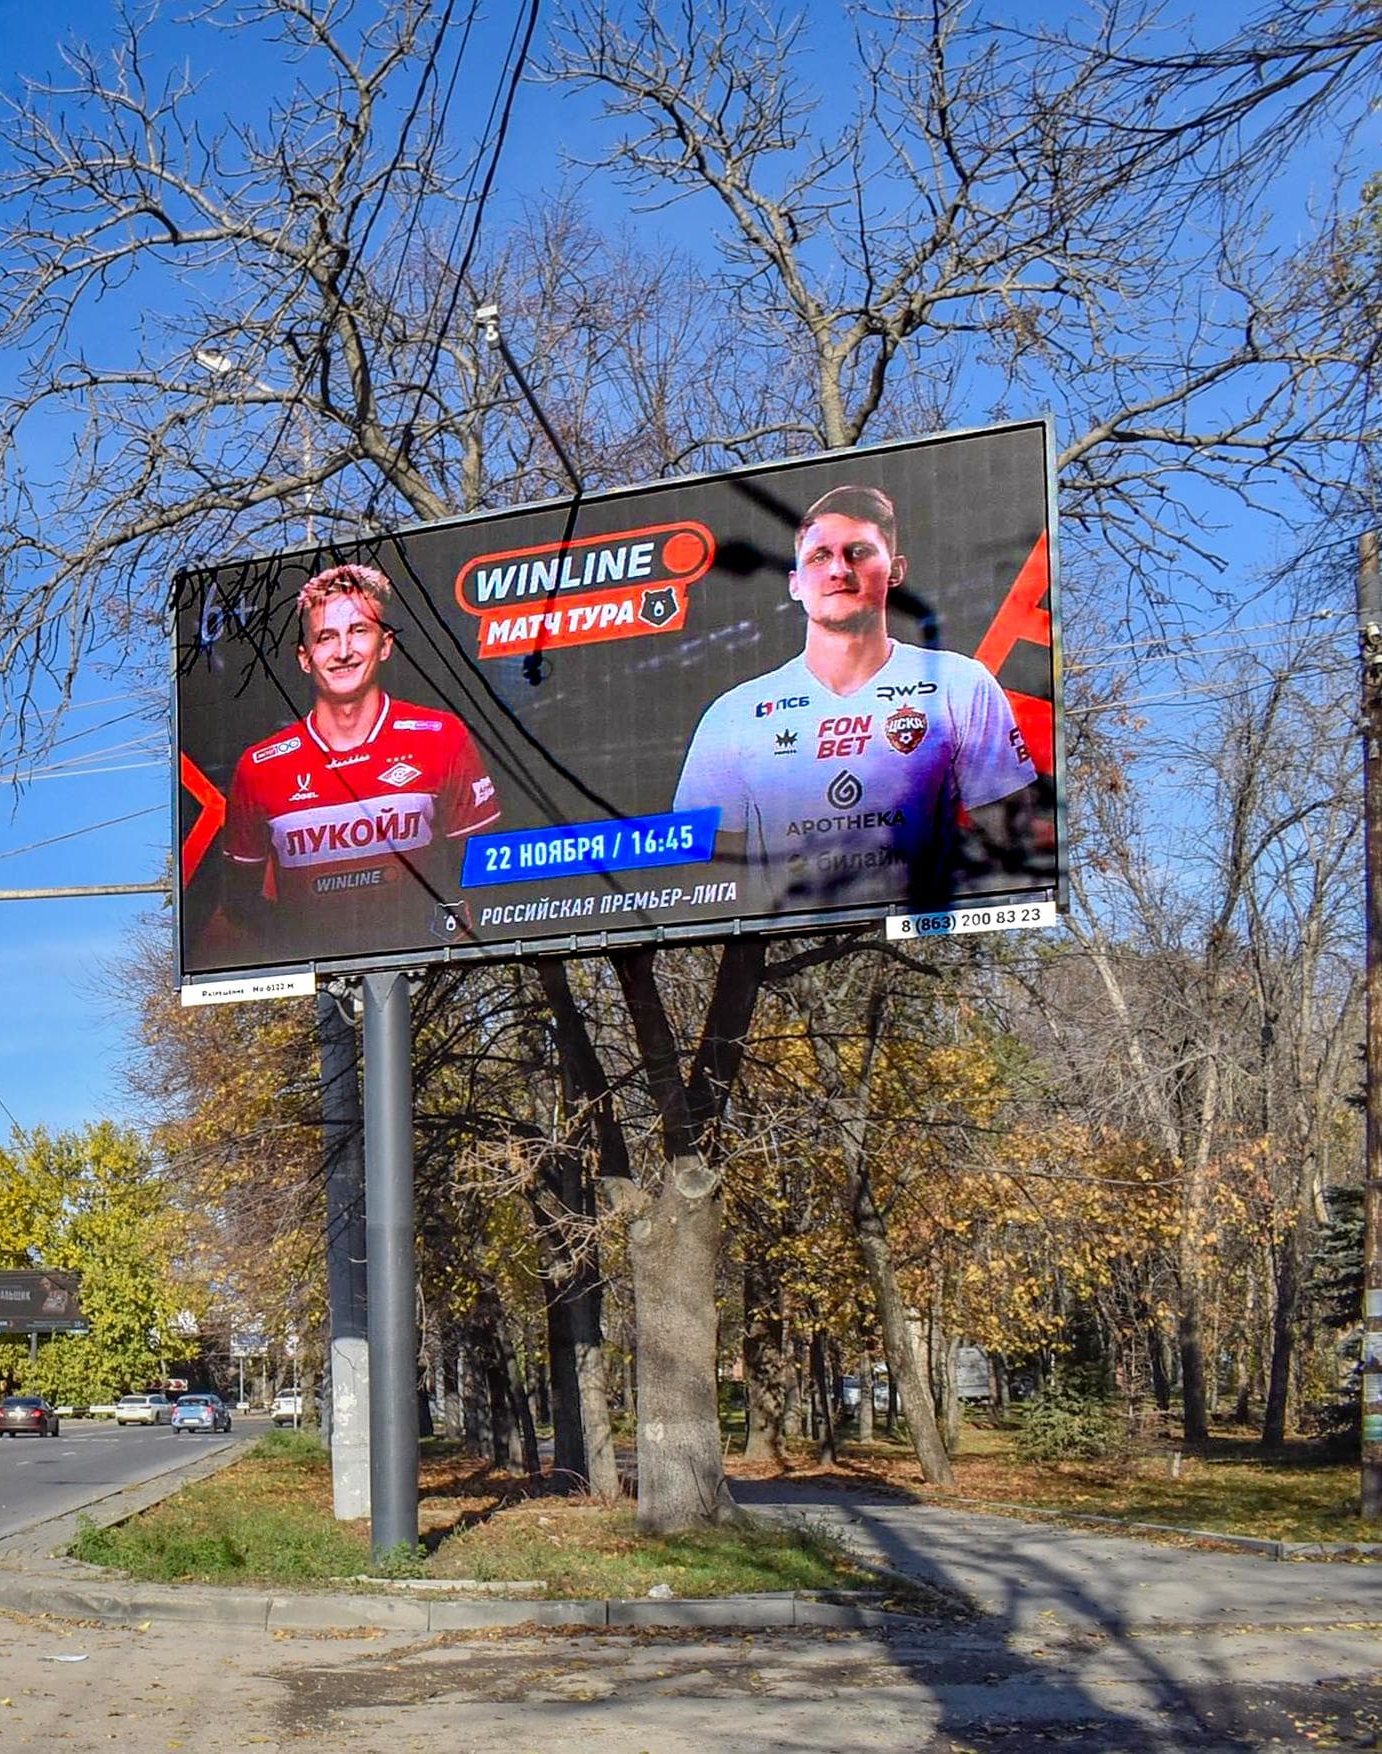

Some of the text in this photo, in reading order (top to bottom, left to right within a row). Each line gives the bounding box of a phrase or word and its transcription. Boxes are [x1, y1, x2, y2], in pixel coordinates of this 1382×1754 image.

[477, 542, 655, 602] WINLINE
[487, 600, 634, 645] МАТЧ ТУРА
[818, 715, 873, 737] FON
[817, 735, 872, 759] BET
[286, 807, 422, 857] ЛУКОЙЛ
[786, 809, 906, 836] APOTHEKA
[486, 846, 511, 871] 22
[520, 835, 604, 868] НОЯБРЯ
[631, 825, 693, 855] 16:45
[317, 870, 382, 892] WINLINE
[480, 882, 737, 926] РОССИЙСКАЯ ПРЕМЬЕР-ЛИГА
[901, 908, 1041, 935] 8 (863) 200 83 23
